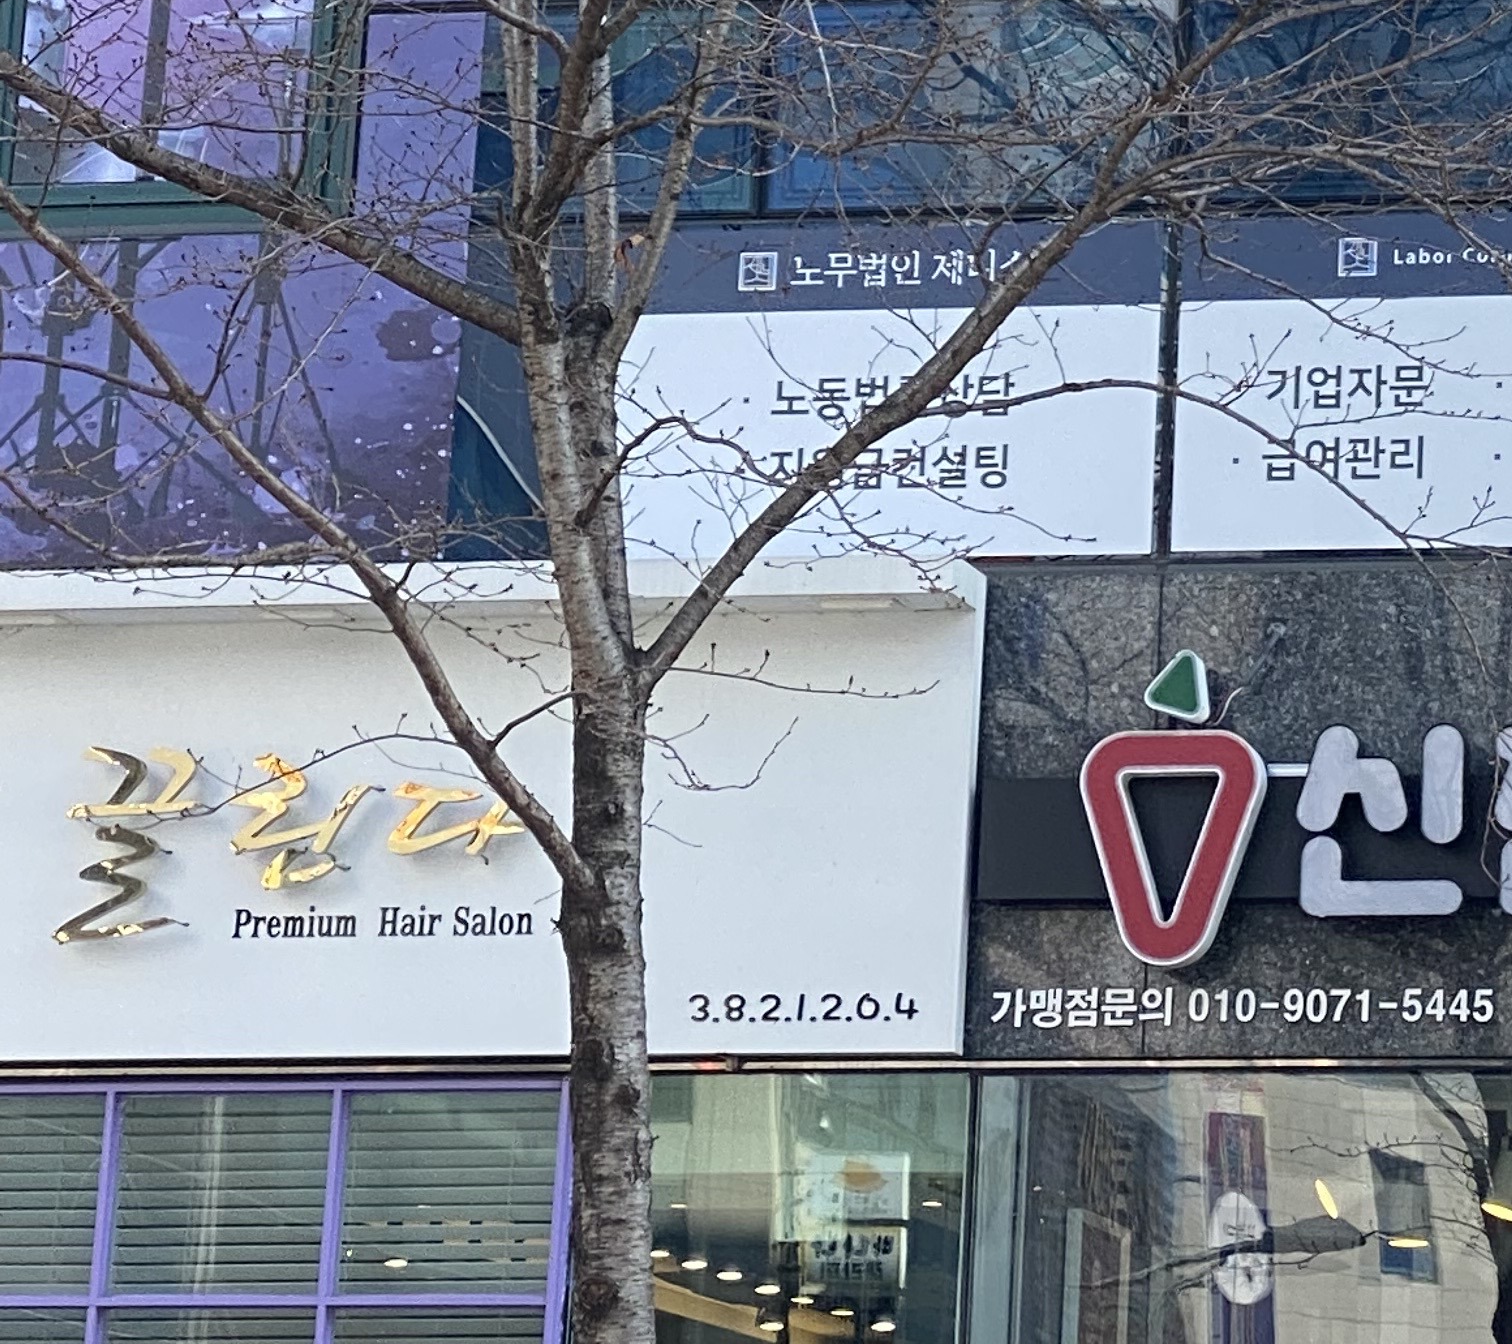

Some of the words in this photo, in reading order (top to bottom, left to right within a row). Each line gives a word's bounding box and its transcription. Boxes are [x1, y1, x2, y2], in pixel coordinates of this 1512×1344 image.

[790, 249, 921, 288] 노무법인
[771, 375, 935, 421] 노동법
[1266, 363, 1431, 410] 기업자문
[1262, 435, 1425, 482] 급여관리
[232, 905, 357, 939] Premium
[378, 904, 442, 937] Hair
[452, 906, 534, 937] Salon
[990, 987, 1174, 1029] 가맹점문의
[1187, 987, 1495, 1026] 010-9071-5445
